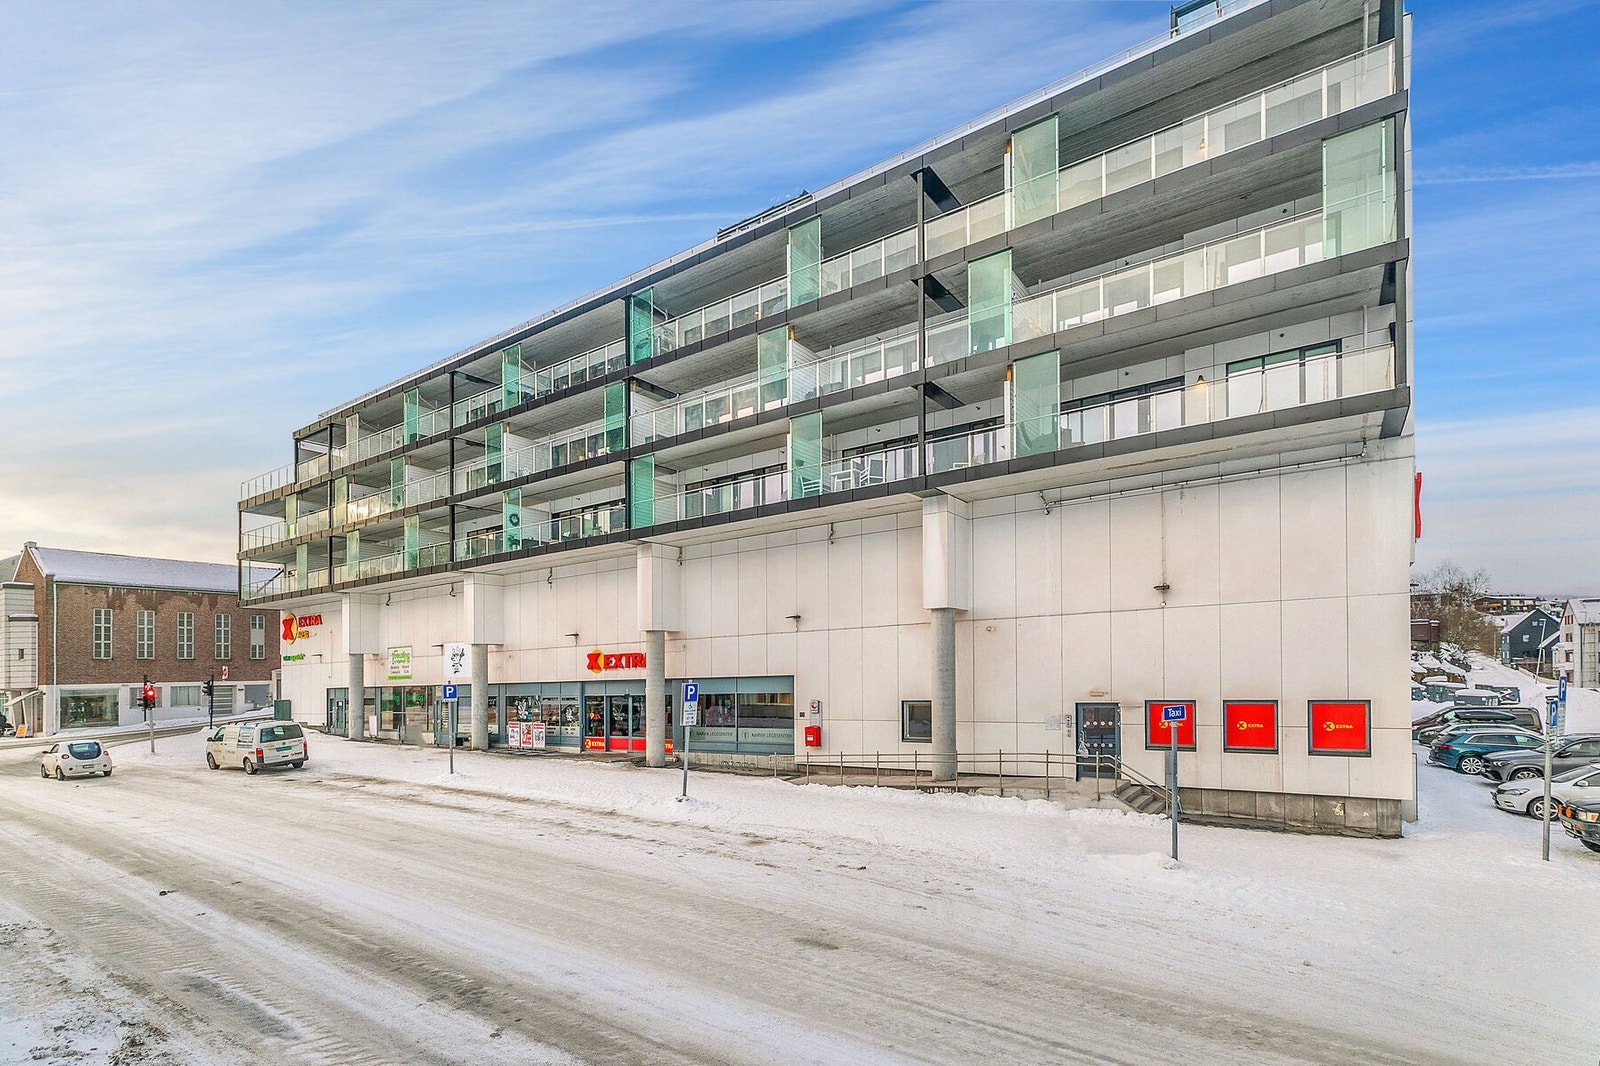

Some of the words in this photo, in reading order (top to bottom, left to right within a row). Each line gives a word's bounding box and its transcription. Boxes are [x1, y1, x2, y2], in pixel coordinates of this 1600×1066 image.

[298, 614, 323, 628] EXTRA
[446, 686, 454, 698] P
[687, 685, 696, 700] P
[1560, 679, 1566, 699] P
[1167, 707, 1182, 718] Taxi
[1551, 703, 1557, 725] P
